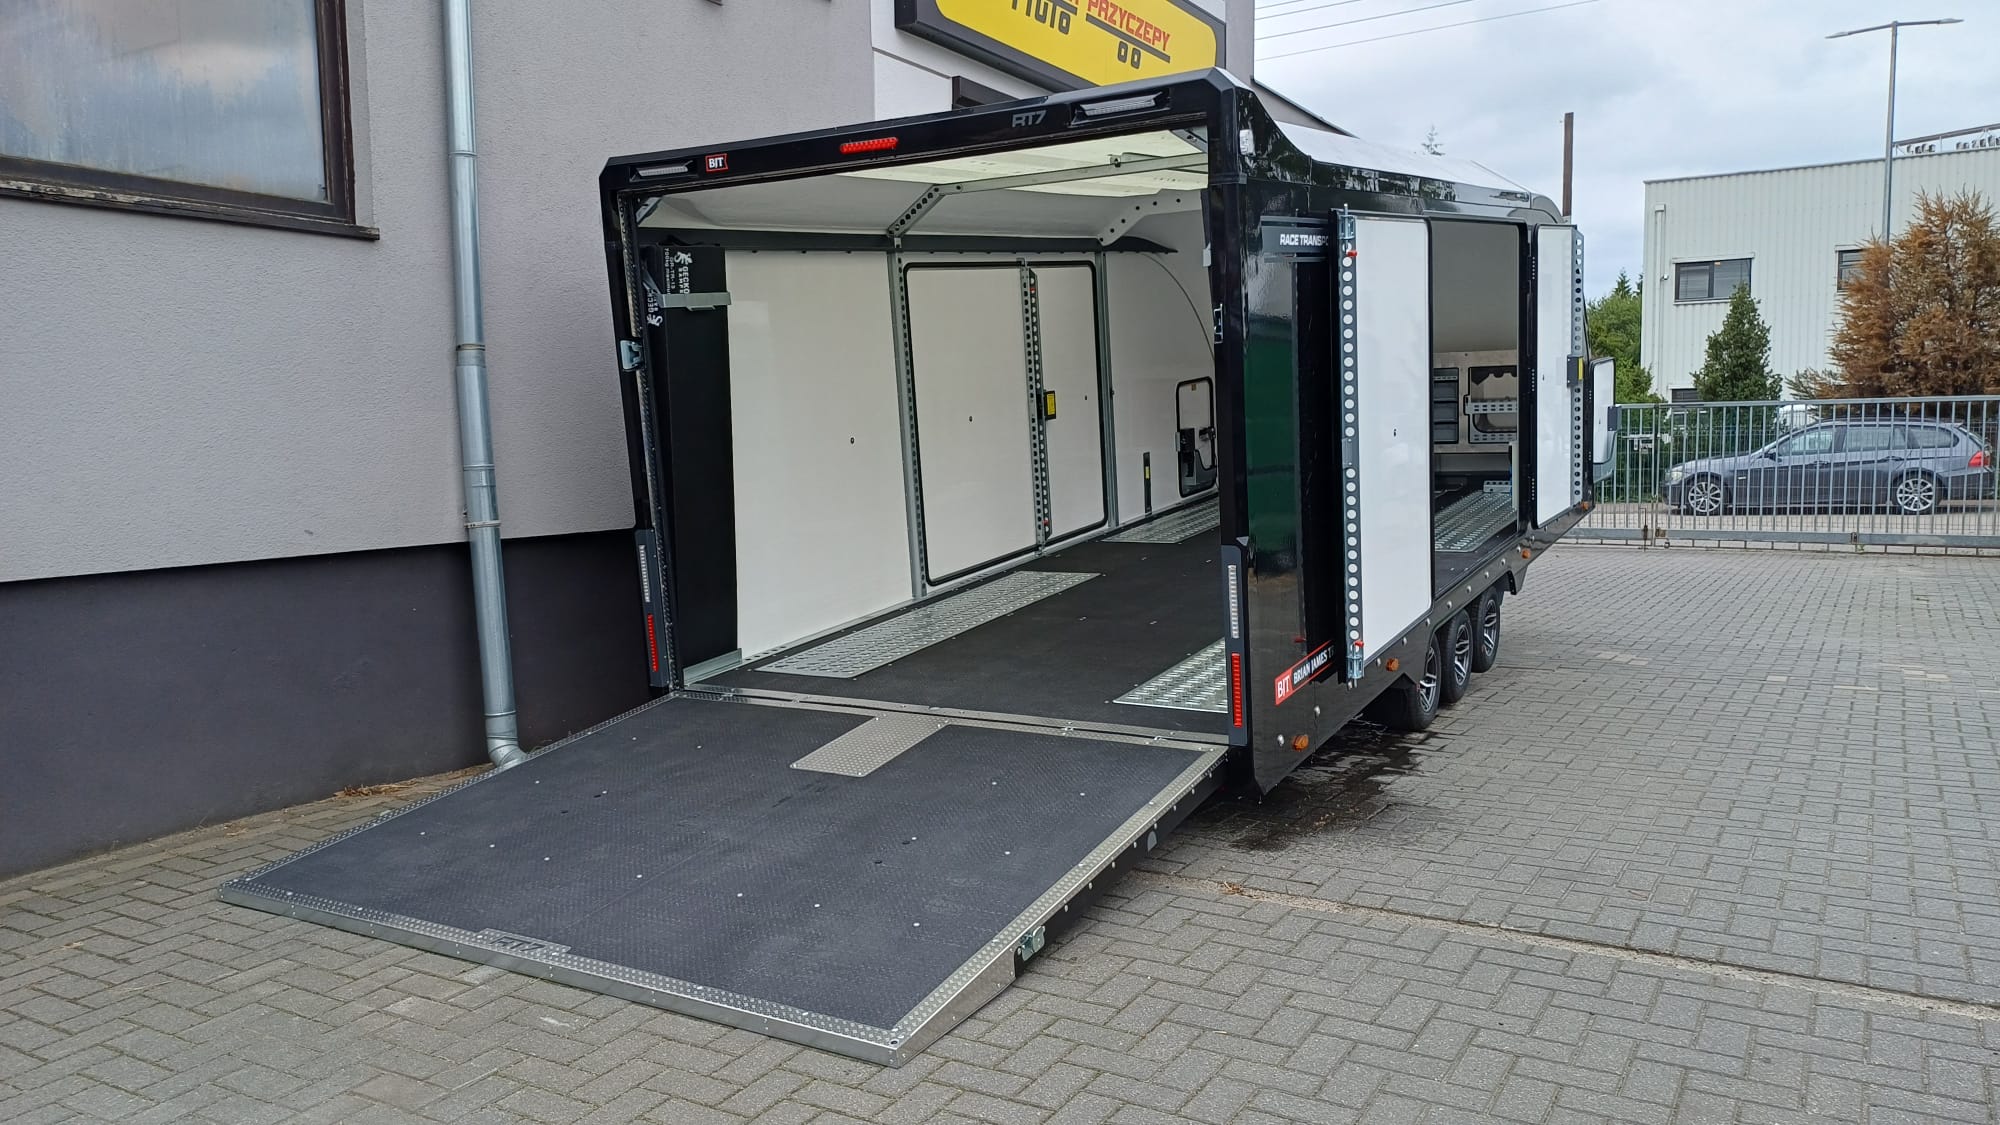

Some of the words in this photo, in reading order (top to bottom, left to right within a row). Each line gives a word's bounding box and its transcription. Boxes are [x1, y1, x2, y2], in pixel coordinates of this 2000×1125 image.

[1087, 0, 1171, 51] PRZYCZEPY
[1012, 110, 1047, 128] RT7
[1280, 234, 1299, 246] RACE
[1293, 661, 1311, 685] BRIAN
[1311, 650, 1328, 674] JAMES
